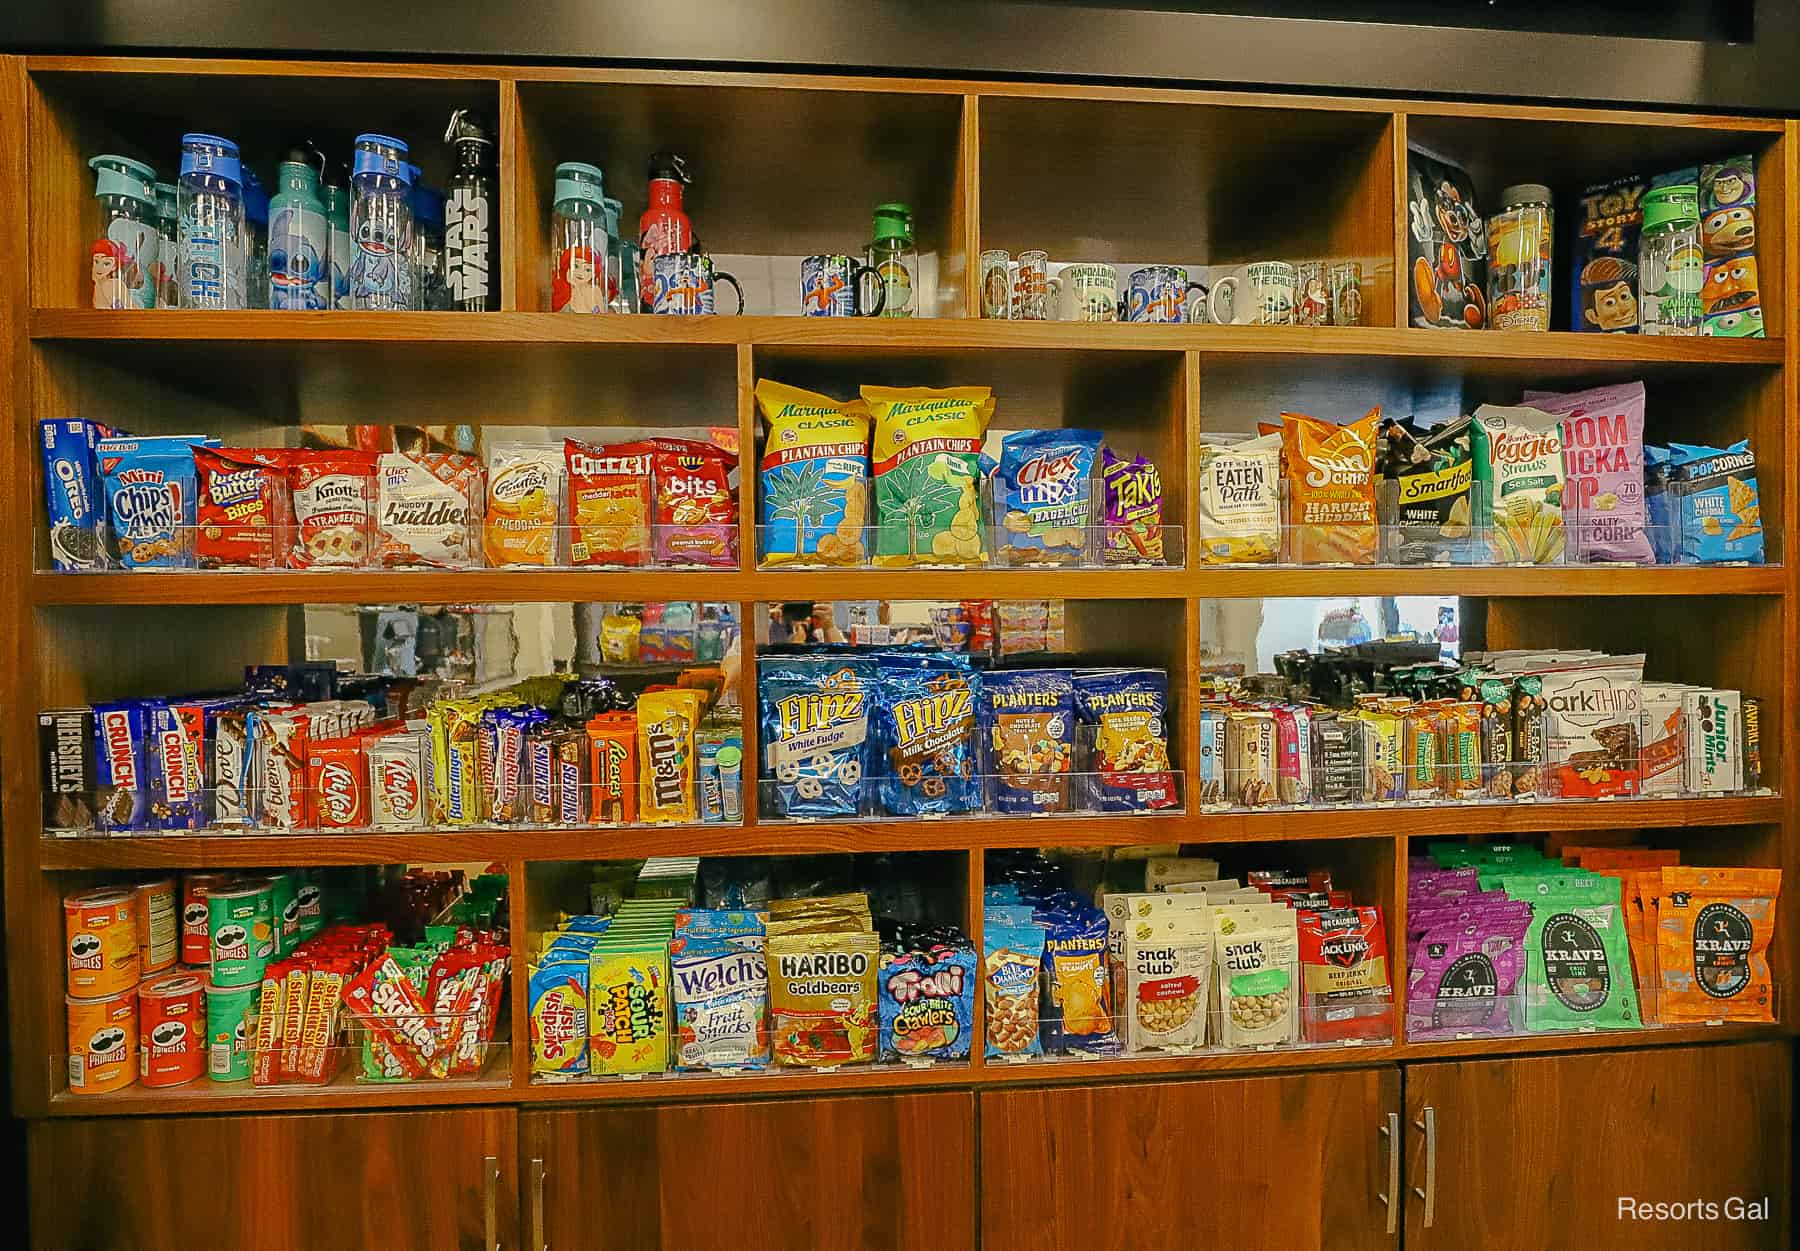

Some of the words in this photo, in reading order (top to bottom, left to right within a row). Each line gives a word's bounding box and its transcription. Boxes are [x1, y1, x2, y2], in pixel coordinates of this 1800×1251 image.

[1587, 212, 1638, 229] STORY
[446, 189, 463, 301] STAR
[463, 189, 489, 300] WARS
[1597, 228, 1622, 250] 4
[190, 203, 220, 298] STITCH
[798, 418, 856, 430] CLASSIC
[906, 411, 967, 426] CLASSIC
[781, 445, 836, 463] PLANTAIN
[837, 442, 866, 456] CHIPS
[897, 441, 945, 462] PLANTAIN
[945, 438, 972, 453] CHIPS
[1487, 430, 1562, 465] Veggie
[1018, 450, 1081, 488] Chex
[1215, 460, 1233, 469] OFF
[1501, 460, 1548, 478] Straws
[118, 468, 164, 487] Mini
[671, 475, 718, 494] bits
[1216, 468, 1264, 486] EATEN
[1331, 471, 1370, 487] CHIPS
[1527, 477, 1546, 487] Salt
[54, 457, 84, 520] OREO
[209, 477, 266, 504] Butter
[1109, 465, 1162, 517] Takis
[1219, 484, 1262, 503] Path
[1623, 483, 1637, 494] 70
[113, 483, 169, 522] Chips
[223, 499, 264, 521] Bites
[398, 501, 427, 510] MUDDY
[1304, 501, 1371, 514] HARVEST
[1695, 496, 1725, 509] WHITE
[384, 500, 470, 527] buddies
[1033, 509, 1069, 524] BAGEL
[1303, 511, 1371, 523] CHEDDAR
[1405, 509, 1440, 521] WHITE
[1591, 516, 1619, 528] SALTY
[495, 518, 543, 532] CHEDDAR
[1593, 526, 1635, 542] CORN
[991, 692, 1059, 709] PLANTERS
[1091, 692, 1154, 711] PLANTERS
[777, 691, 864, 744] Flipz
[893, 688, 973, 749] Flipz
[1260, 720, 1272, 758] QUEST
[1714, 697, 1729, 762] Junior
[788, 738, 816, 752] White
[816, 729, 845, 747] Fudge
[902, 744, 924, 759] Milk
[924, 725, 966, 750] Chocolate
[1215, 721, 1225, 759] QUEST
[56, 714, 84, 793] HERSHEY'S
[107, 713, 137, 790] CRUNCH
[1704, 734, 1716, 774] Mints
[164, 733, 186, 800] CRUNCH
[533, 742, 551, 807] SNICKERS
[216, 739, 240, 816] Dove
[267, 757, 285, 806] bueno
[449, 748, 463, 819] Butterfinger
[563, 763, 578, 823] SNICKERS
[1302, 899, 1329, 908] CALORIES
[1333, 916, 1360, 928] CALORIES
[216, 945, 248, 961] PRINGLES
[1047, 938, 1104, 953] PLANTERS
[1137, 947, 1177, 961] snak
[1225, 941, 1263, 957] snak
[1319, 944, 1342, 957] JACK
[1695, 939, 1752, 951] KRAVE
[71, 955, 102, 970] PRINGLES
[781, 953, 869, 978] HARIBO
[1226, 956, 1262, 970] club
[1544, 949, 1605, 962] KRAVE
[678, 957, 769, 997] Welch's
[1137, 961, 1174, 975] club
[788, 980, 861, 996] Goldbears
[889, 965, 964, 1004] Trolli
[1439, 984, 1496, 998] KRAVE
[609, 982, 636, 1044] PATCH
[628, 983, 651, 1040] SOUR
[707, 1009, 746, 1027] Fruit
[904, 1003, 927, 1017] SOUR
[927, 999, 954, 1011] BRITE
[543, 991, 565, 1060] Swedish
[558, 1004, 575, 1045] Fish
[698, 1020, 752, 1043] Snacks
[893, 1009, 956, 1035] Crawlers
[88, 1047, 127, 1068] PRINGLES
[152, 1041, 186, 1058] PRINGLES
